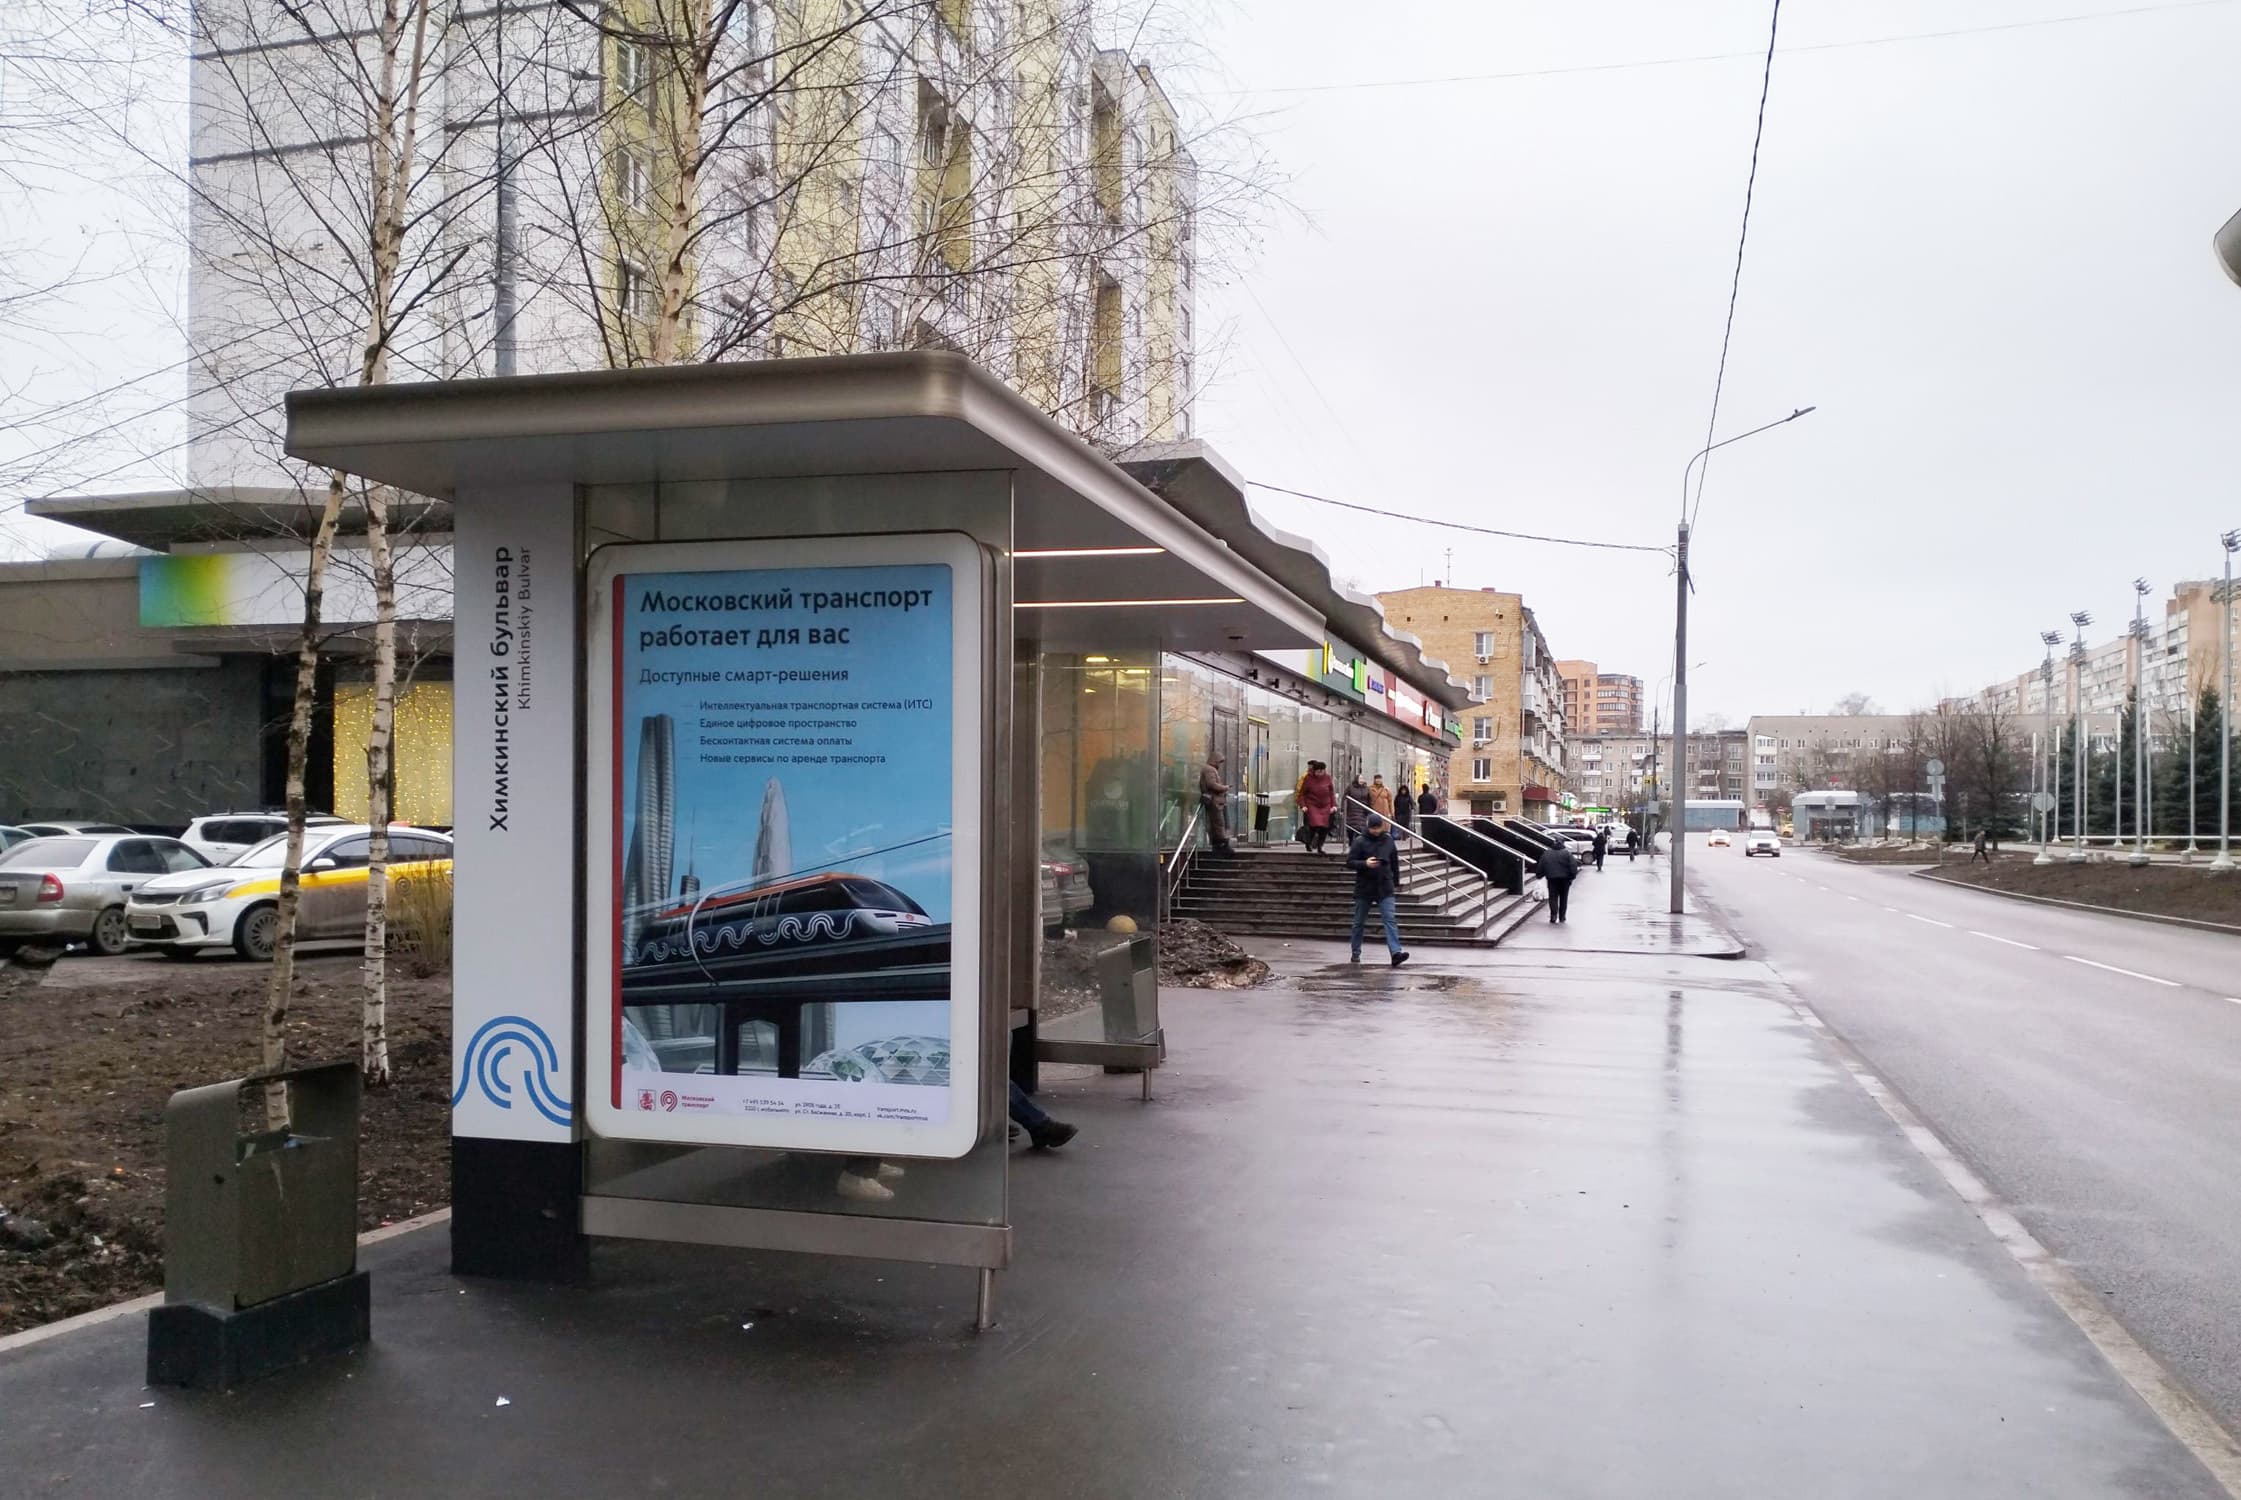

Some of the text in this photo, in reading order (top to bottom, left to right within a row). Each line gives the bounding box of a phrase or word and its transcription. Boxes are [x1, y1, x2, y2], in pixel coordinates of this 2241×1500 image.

[640, 588, 933, 614] Московский транспорт
[518, 547, 533, 710] Khimkinskiy Bulvar
[640, 624, 850, 652] работает для вас
[640, 668, 849, 685] Доступные смарт-решения
[490, 546, 513, 832] Химкинский бульвар
[700, 699, 933, 712] Интеллектуальная транспортная система (ИТС)
[700, 718, 858, 729] Единое цифровое пространство
[700, 735, 853, 746] Бесконтактная система оплаты
[700, 754, 886, 765] Новые сервисы по аренде транспорта
